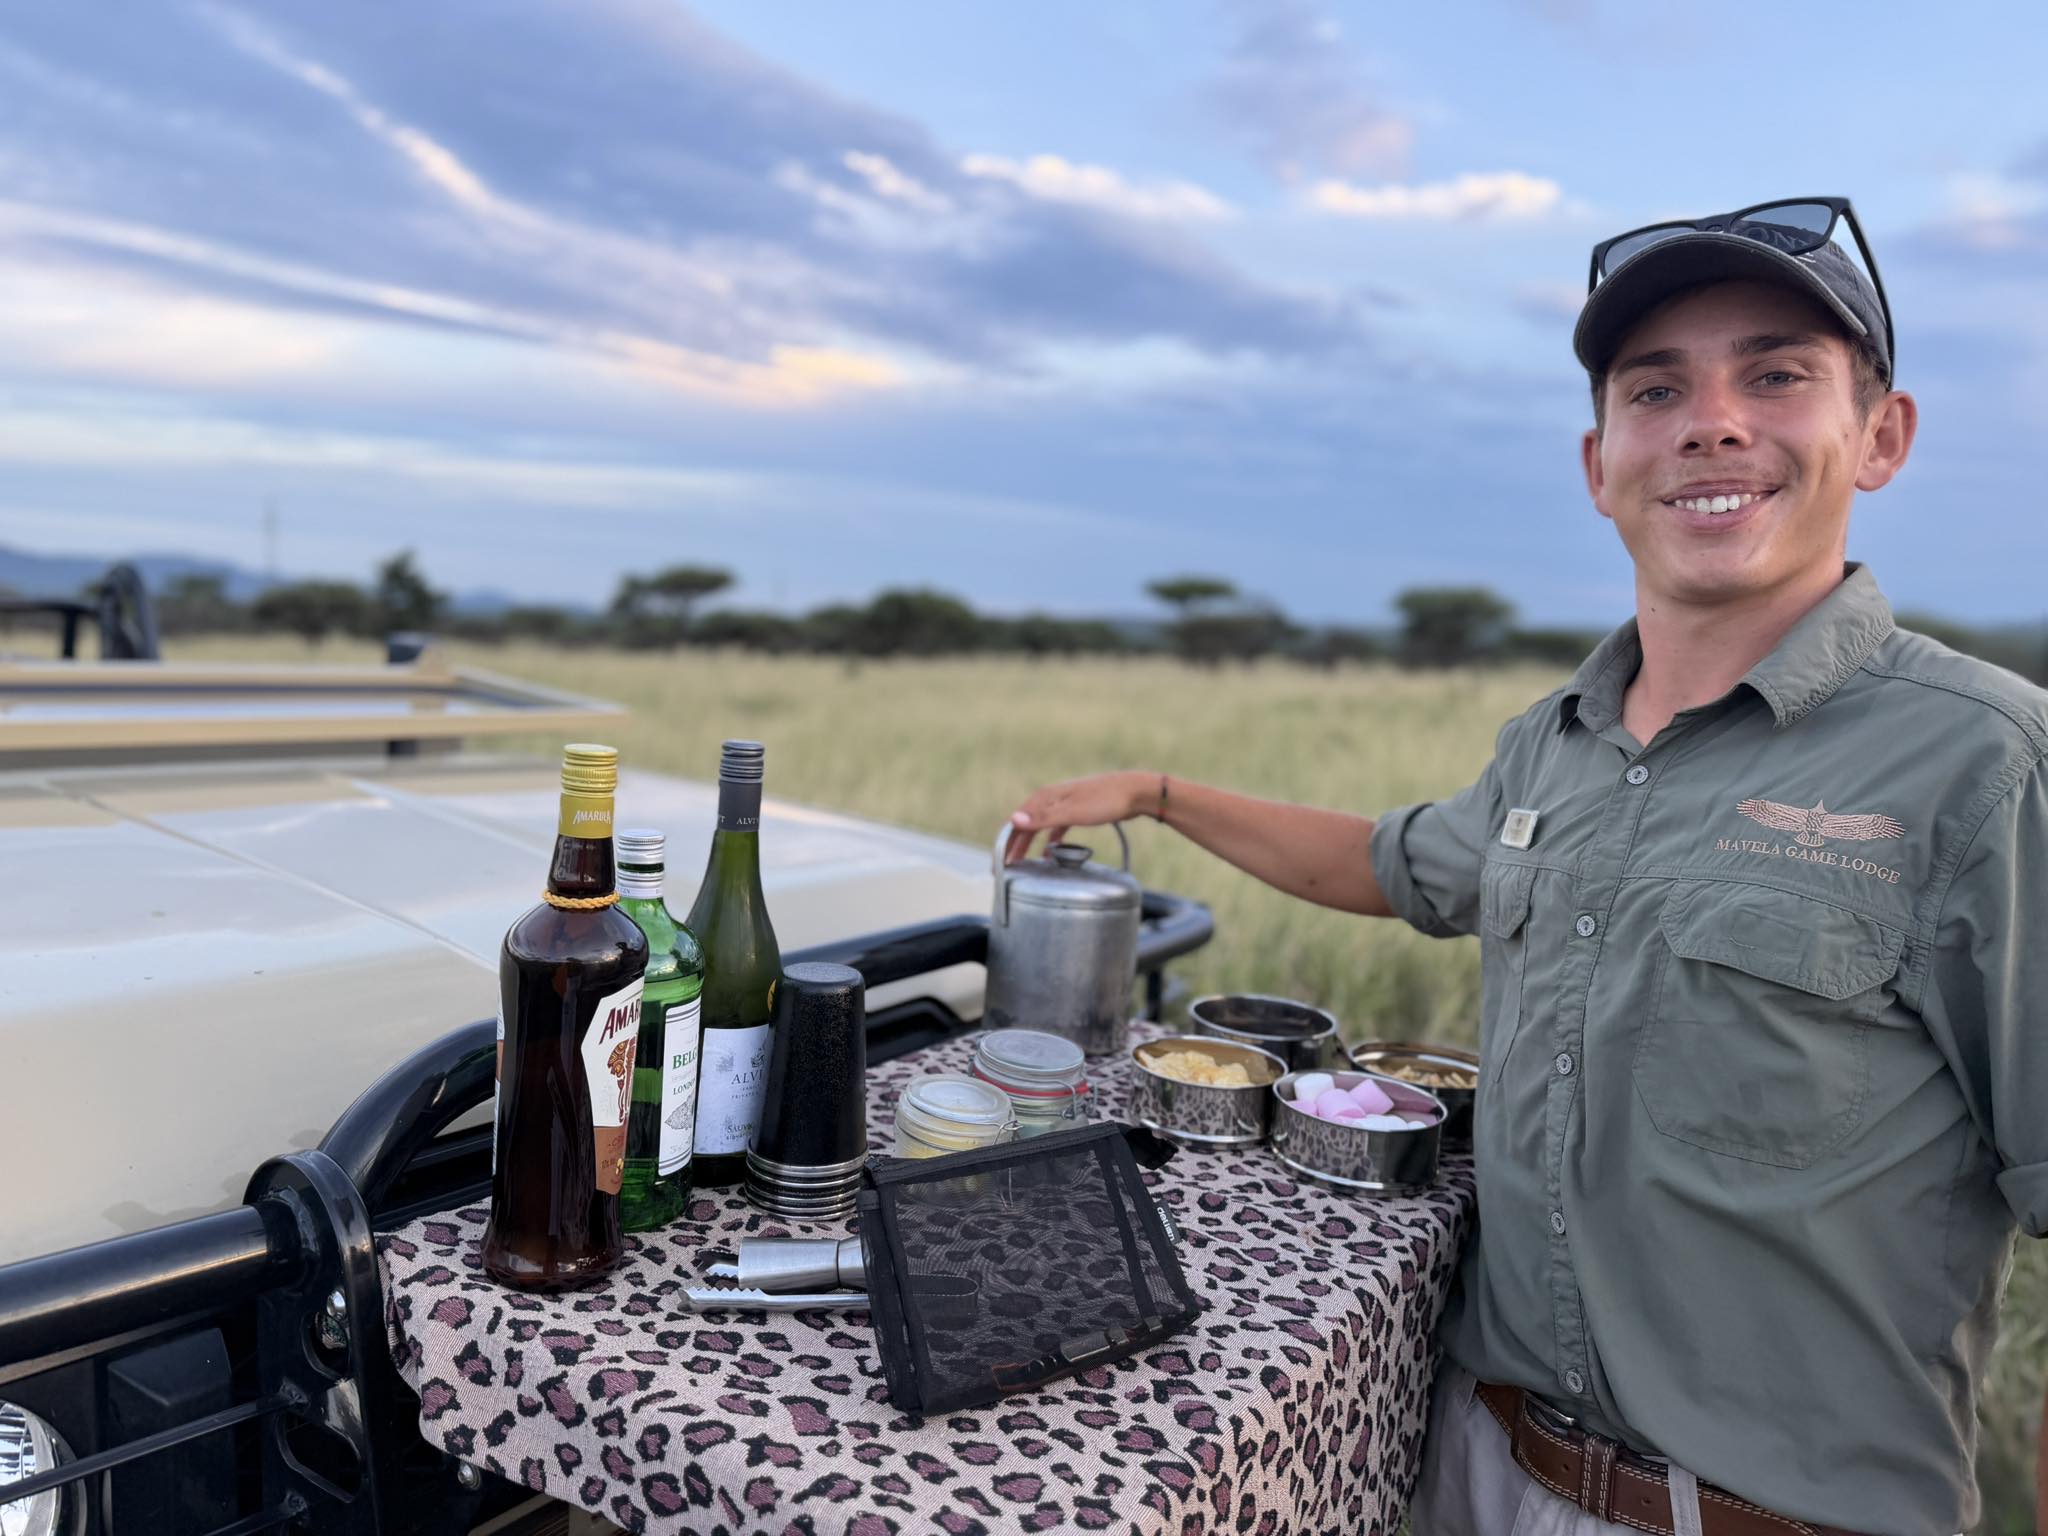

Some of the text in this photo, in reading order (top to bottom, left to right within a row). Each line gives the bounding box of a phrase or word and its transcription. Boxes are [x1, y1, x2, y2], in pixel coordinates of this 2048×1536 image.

[572, 809, 611, 825] AMARULA
[1714, 839, 1901, 885] MAVELA GAME LODGE
